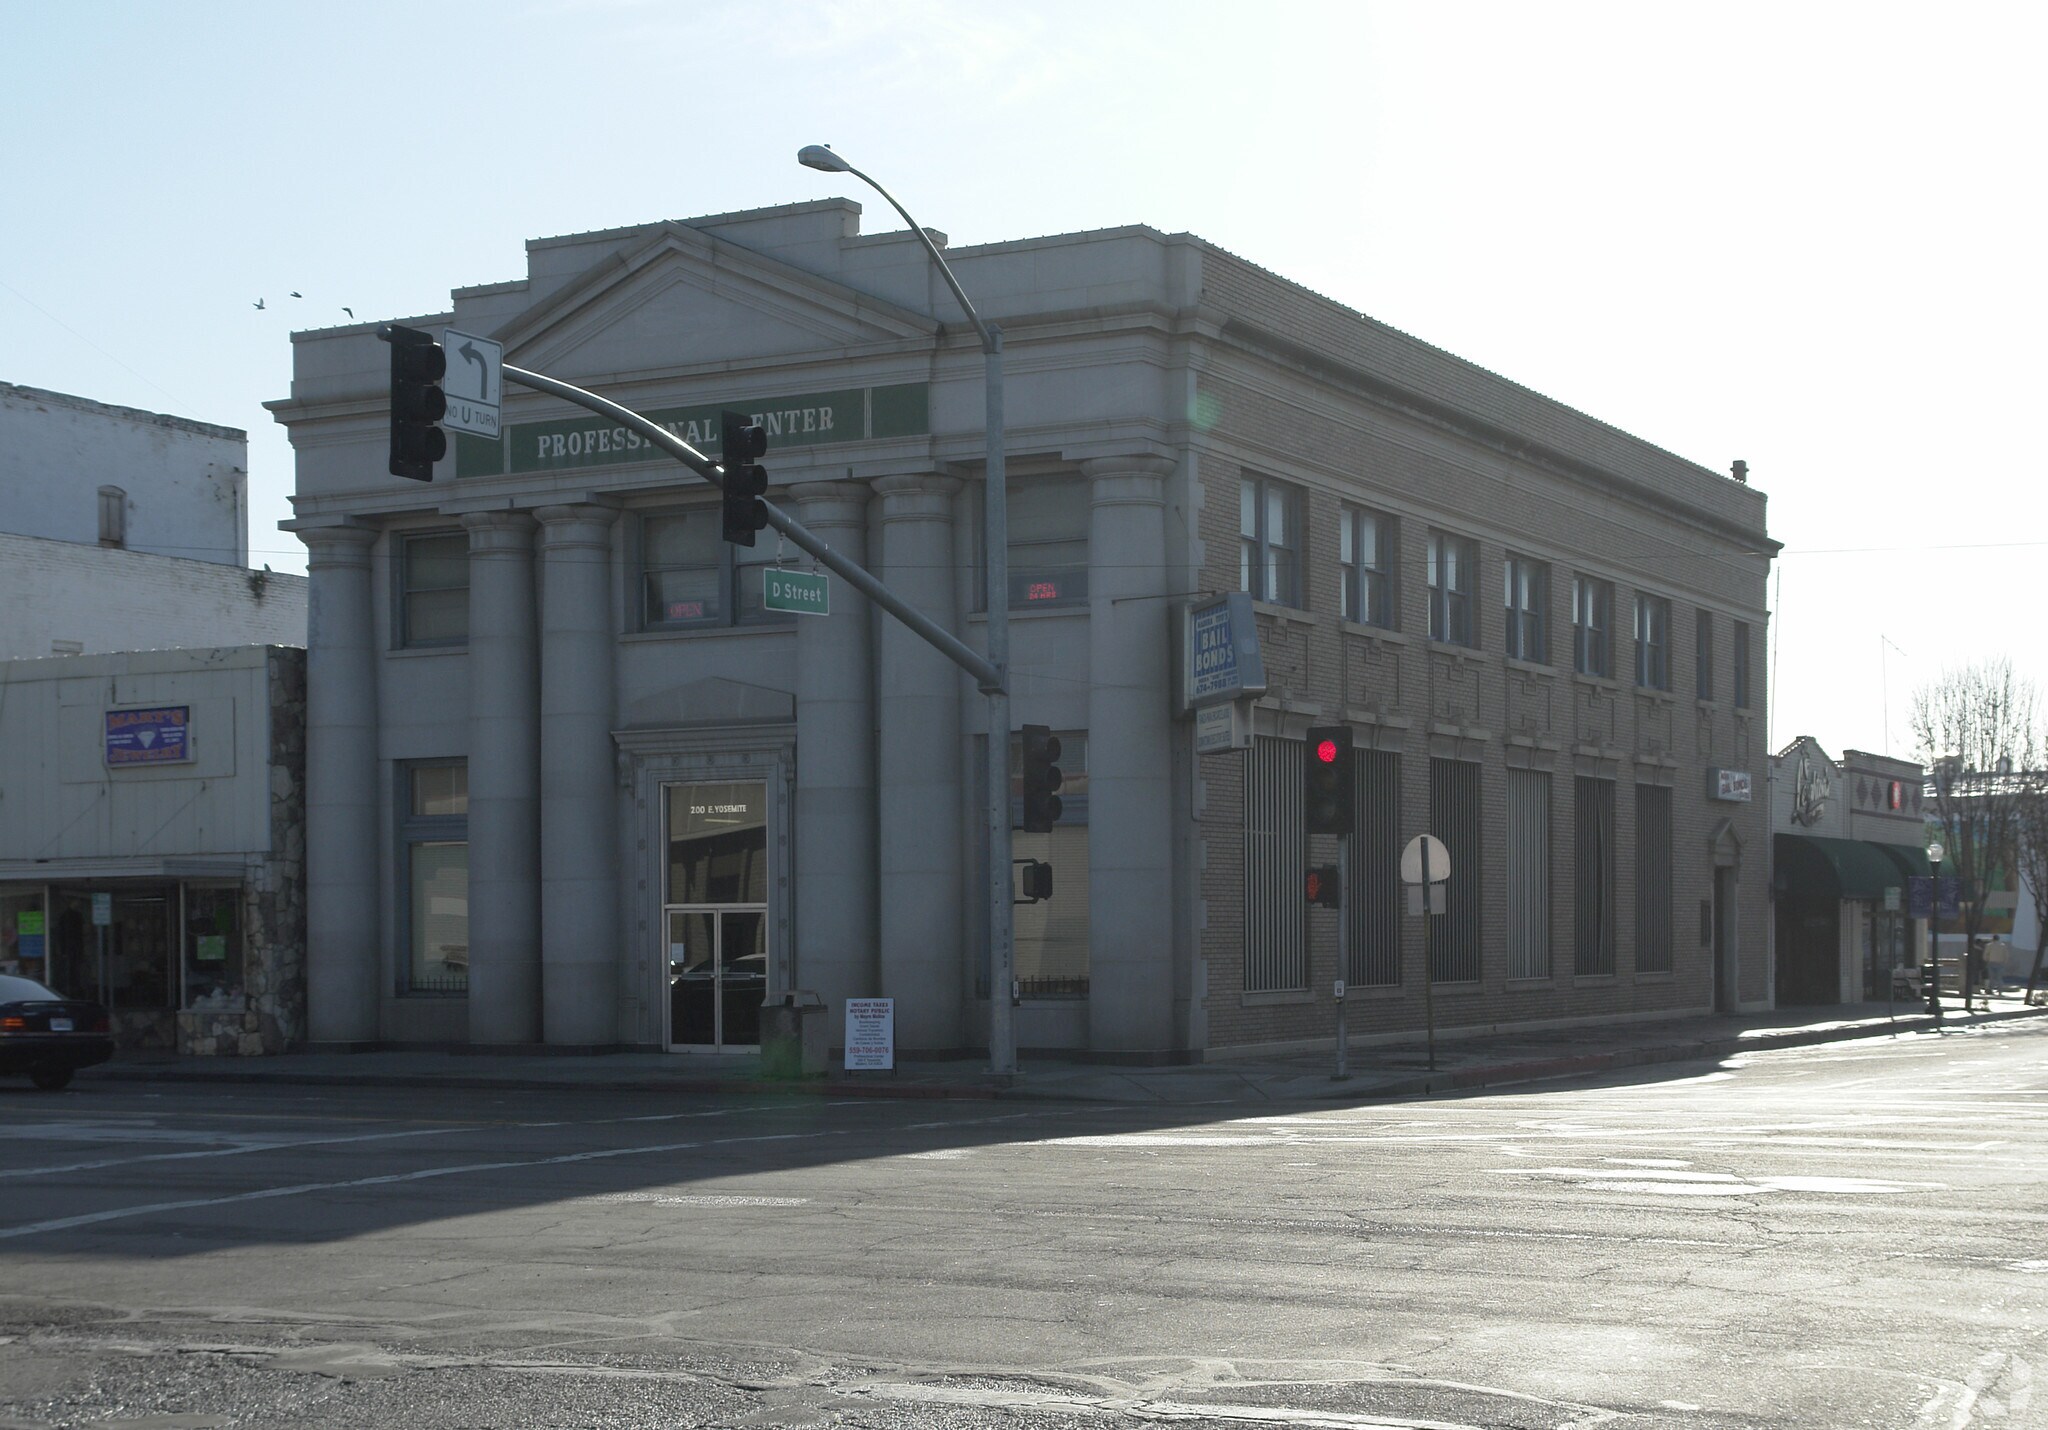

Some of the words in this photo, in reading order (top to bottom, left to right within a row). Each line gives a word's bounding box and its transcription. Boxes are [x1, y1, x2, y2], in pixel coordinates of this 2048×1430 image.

[446, 404, 457, 418] NO
[462, 406, 470, 424] U
[475, 411, 497, 429] TURN
[537, 419, 717, 458] PROFESSNAL
[773, 582, 781, 597] D
[784, 583, 821, 603] Street
[1029, 583, 1055, 593] OPEN
[668, 603, 702, 618] OPEN
[1202, 627, 1227, 650] BAIL
[1196, 644, 1233, 671] BONDS
[109, 710, 184, 731] MARY'S
[110, 742, 184, 762] JEWELRY
[690, 806, 705, 814] 200
